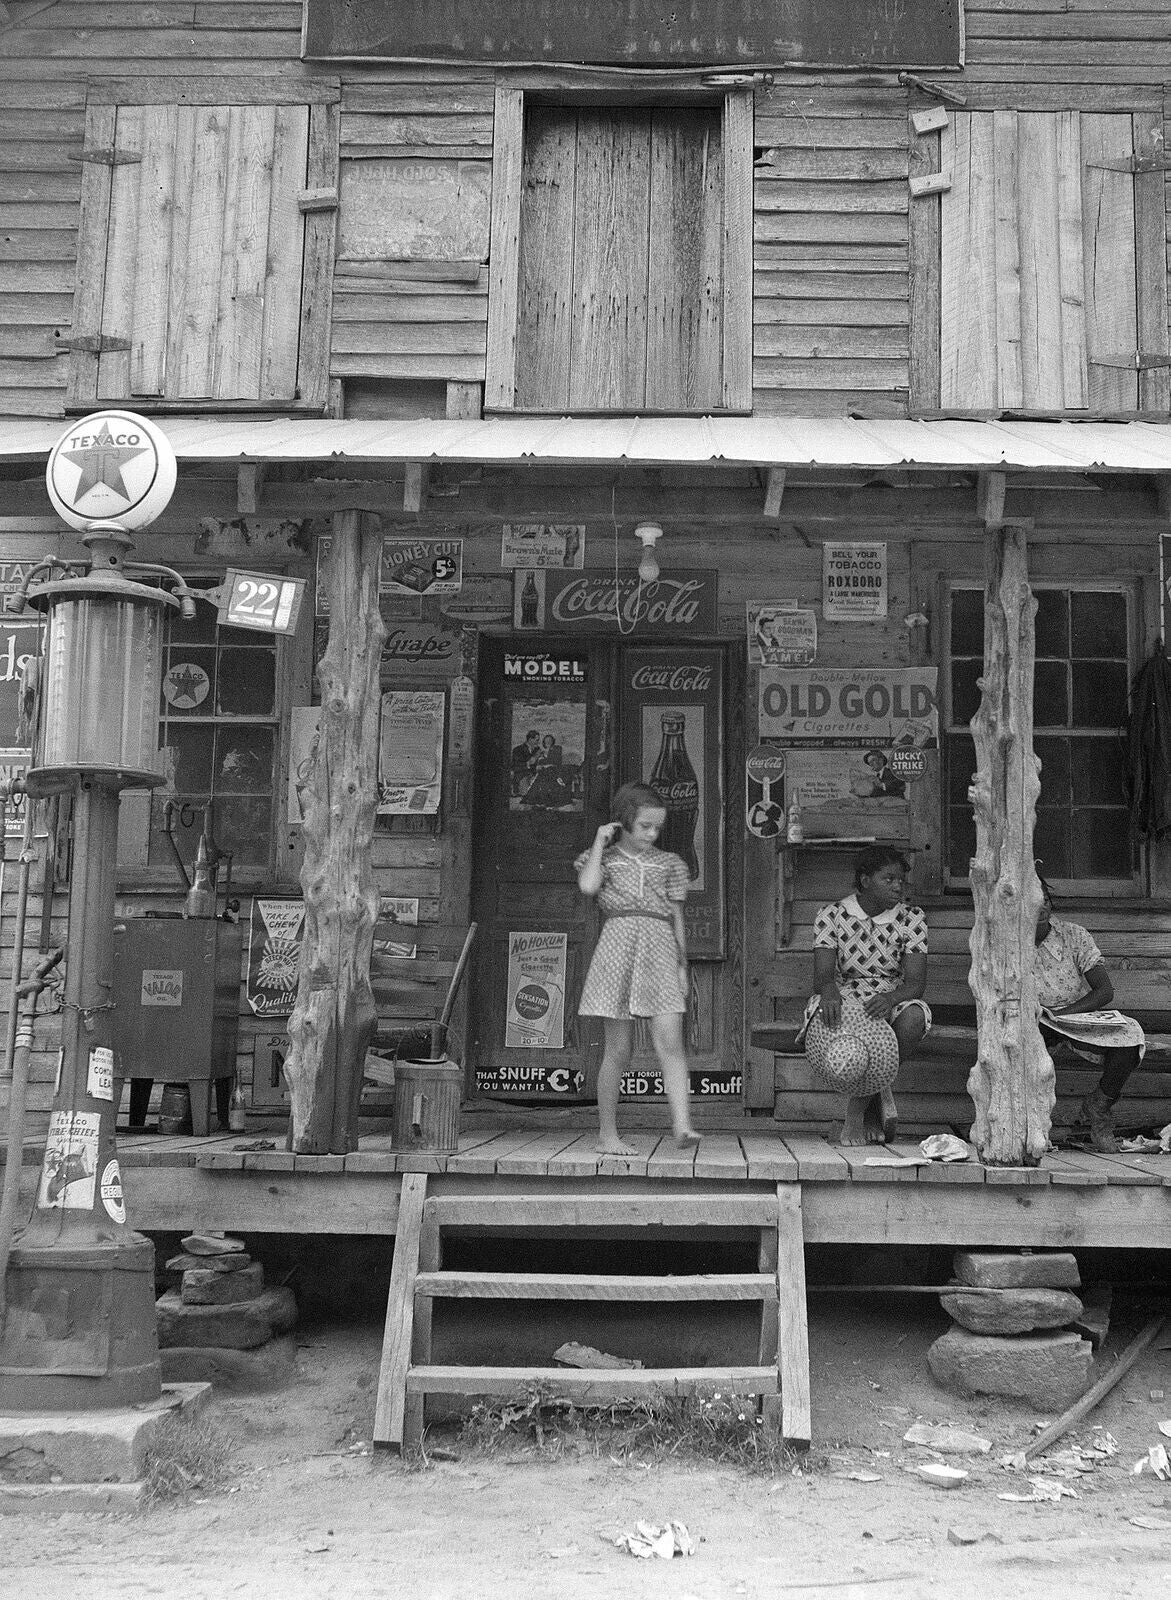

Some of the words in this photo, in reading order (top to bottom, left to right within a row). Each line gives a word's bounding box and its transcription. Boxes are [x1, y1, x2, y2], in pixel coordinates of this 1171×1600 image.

[70, 434, 140, 449] TEXACO
[383, 544, 431, 569] HONEY
[433, 542, 460, 556] CUT
[828, 561, 882, 569] TOBACCO
[593, 578, 637, 586] DRINK
[828, 575, 882, 588] ROXBORO
[235, 580, 279, 616] 22
[552, 578, 706, 623] Coca-Cola
[385, 630, 453, 661] Grape
[764, 652, 810, 663] AMEL
[504, 660, 584, 676] MODEL
[171, 672, 204, 680] TEXACO
[632, 665, 713, 690] Coca-Cola
[763, 683, 831, 718] OLD
[839, 683, 934, 718] GOLD
[803, 721, 870, 734] Cigarettes
[748, 756, 782, 769] Coca-Cola
[894, 752, 921, 760] LUCKY
[892, 761, 924, 770] STRIKE
[685, 905, 713, 917] ere
[277, 929, 288, 939] of
[684, 922, 710, 938] old
[511, 936, 528, 955] NO
[528, 935, 565, 950] HOKUM
[252, 992, 297, 1012] Quality
[517, 991, 549, 1007] SENSATION
[476, 1071, 498, 1080] THAT
[499, 1067, 546, 1080] SNUFF
[476, 1082, 498, 1092] YOU
[502, 1083, 533, 1091] WANT
[536, 1083, 545, 1091] IS
[620, 1078, 649, 1094] RED
[654, 1078, 695, 1094] SL
[701, 1076, 742, 1094] Snuff
